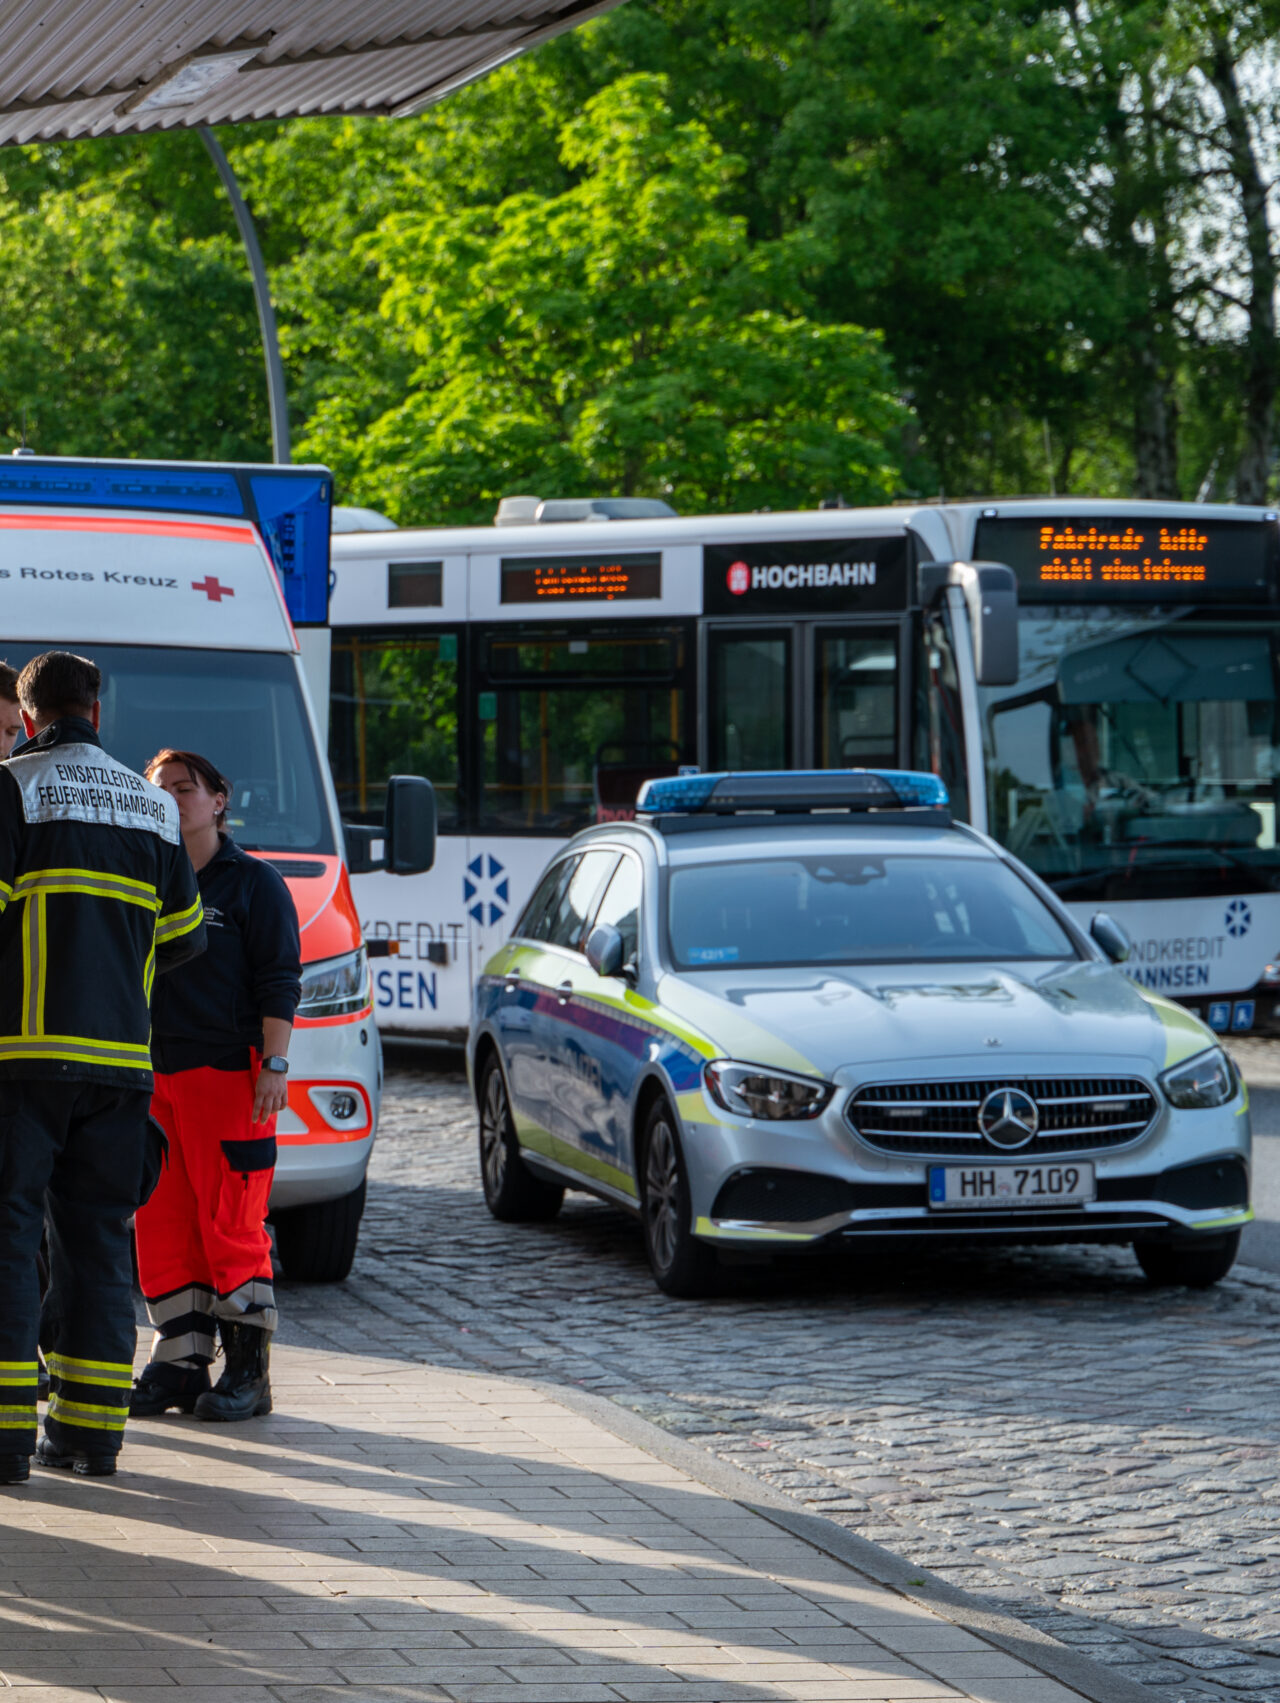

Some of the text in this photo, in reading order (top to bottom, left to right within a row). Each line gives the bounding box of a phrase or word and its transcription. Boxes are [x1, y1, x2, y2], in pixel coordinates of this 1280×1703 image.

[20, 567, 94, 582] Rotes
[104, 571, 178, 589] Kreuz
[752, 563, 875, 588] HOCHBAHN
[55, 764, 145, 793] EINSATZLEITER
[38, 786, 165, 824] FEUERWEHR HAMBURG
[362, 920, 464, 961] REDIT
[1130, 936, 1226, 964] NDKREDIT
[371, 970, 438, 1010] SEN
[961, 1168, 1079, 1197] HH 7109
